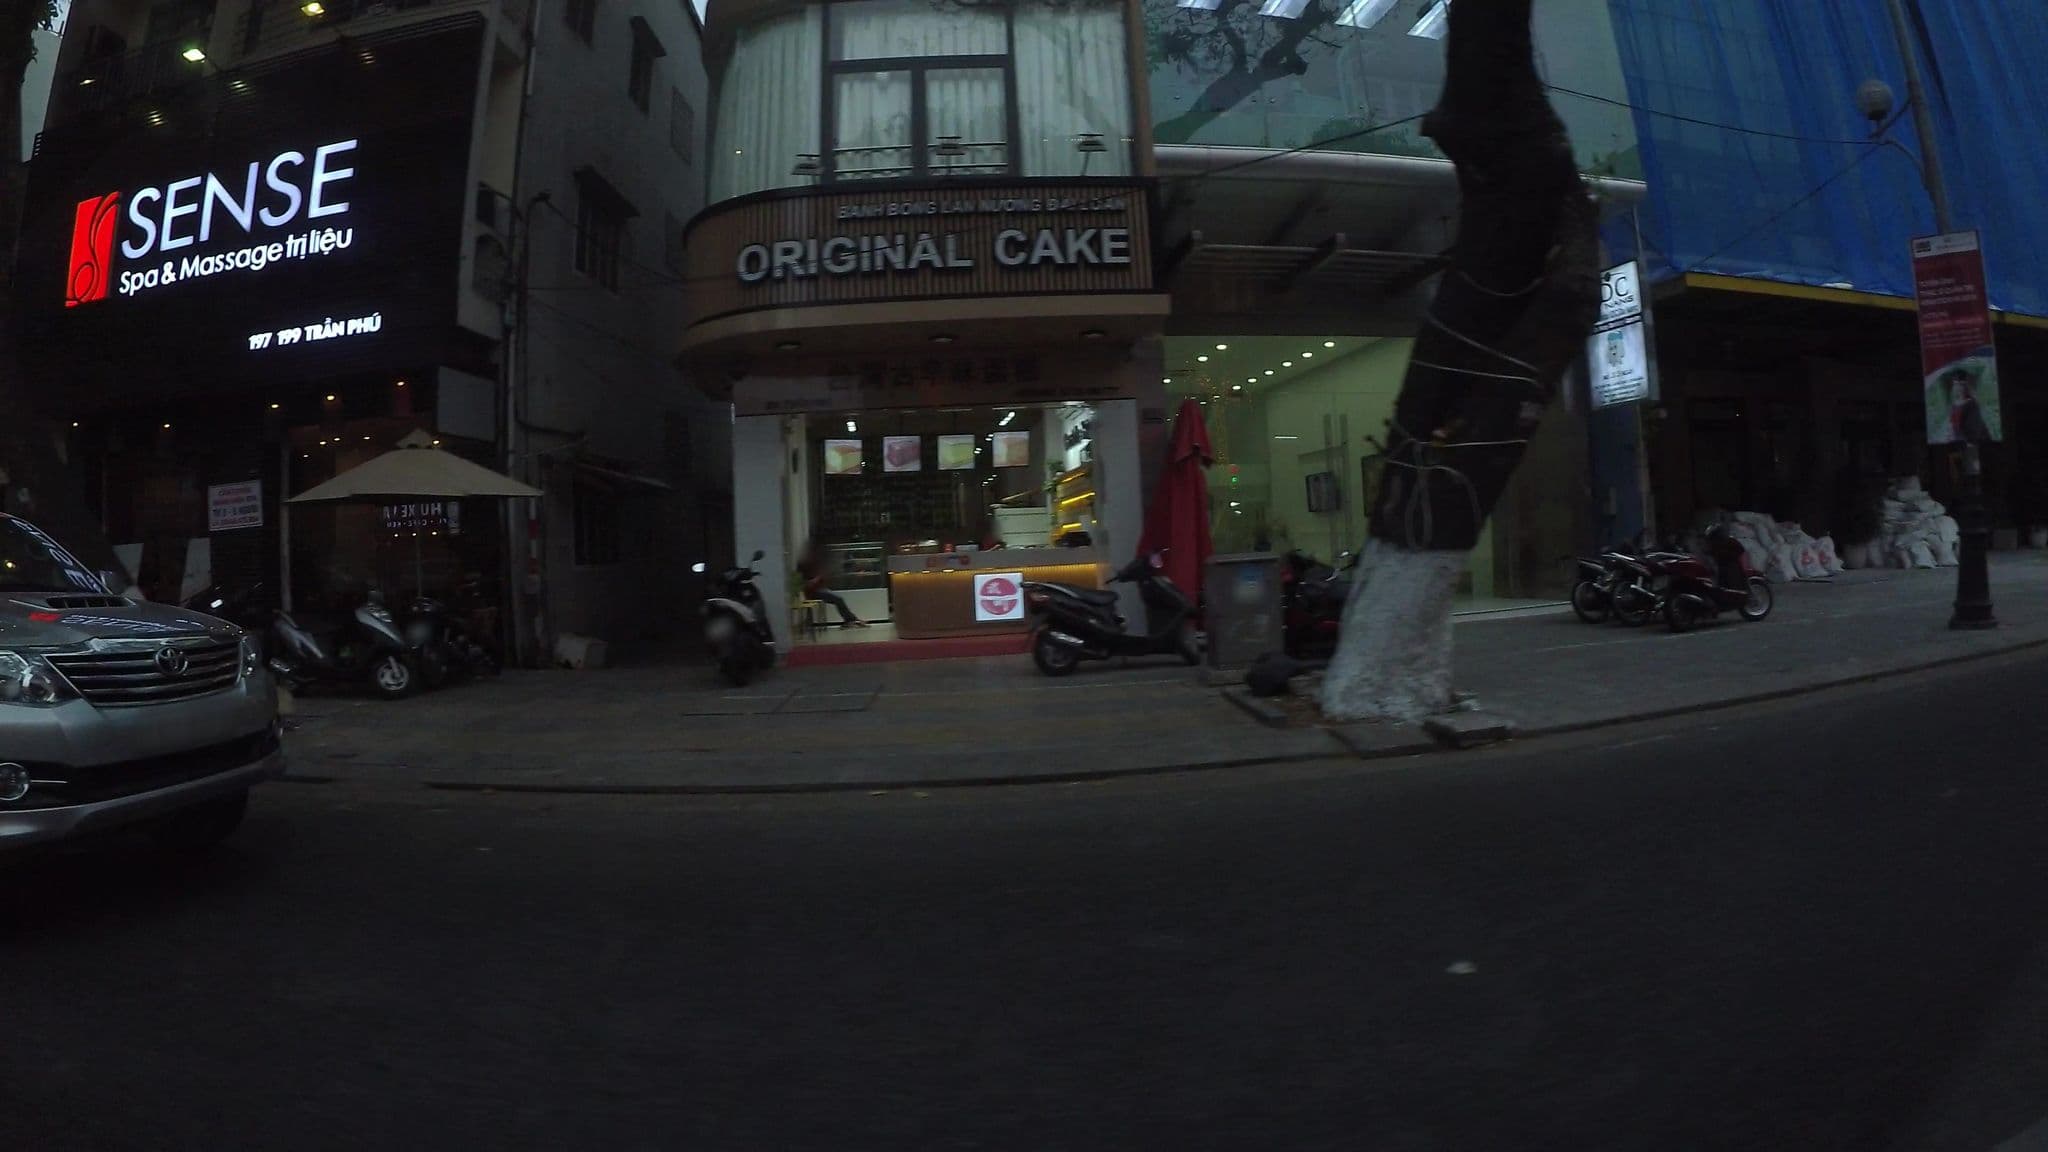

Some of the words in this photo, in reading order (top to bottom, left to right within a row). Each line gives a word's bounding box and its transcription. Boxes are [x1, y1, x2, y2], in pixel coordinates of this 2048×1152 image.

[121, 138, 358, 260] SENSE
[119, 269, 159, 296] Spa
[160, 261, 176, 286] &
[179, 242, 282, 282] Massage
[286, 232, 308, 260] trị
[308, 227, 352, 256] liệu
[737, 232, 975, 283] ORIGINAL
[994, 227, 1131, 267] CAKE
[247, 332, 272, 351] 197
[276, 327, 301, 346] 199
[304, 317, 345, 343] TRẦN
[347, 312, 382, 335] PHÚ
